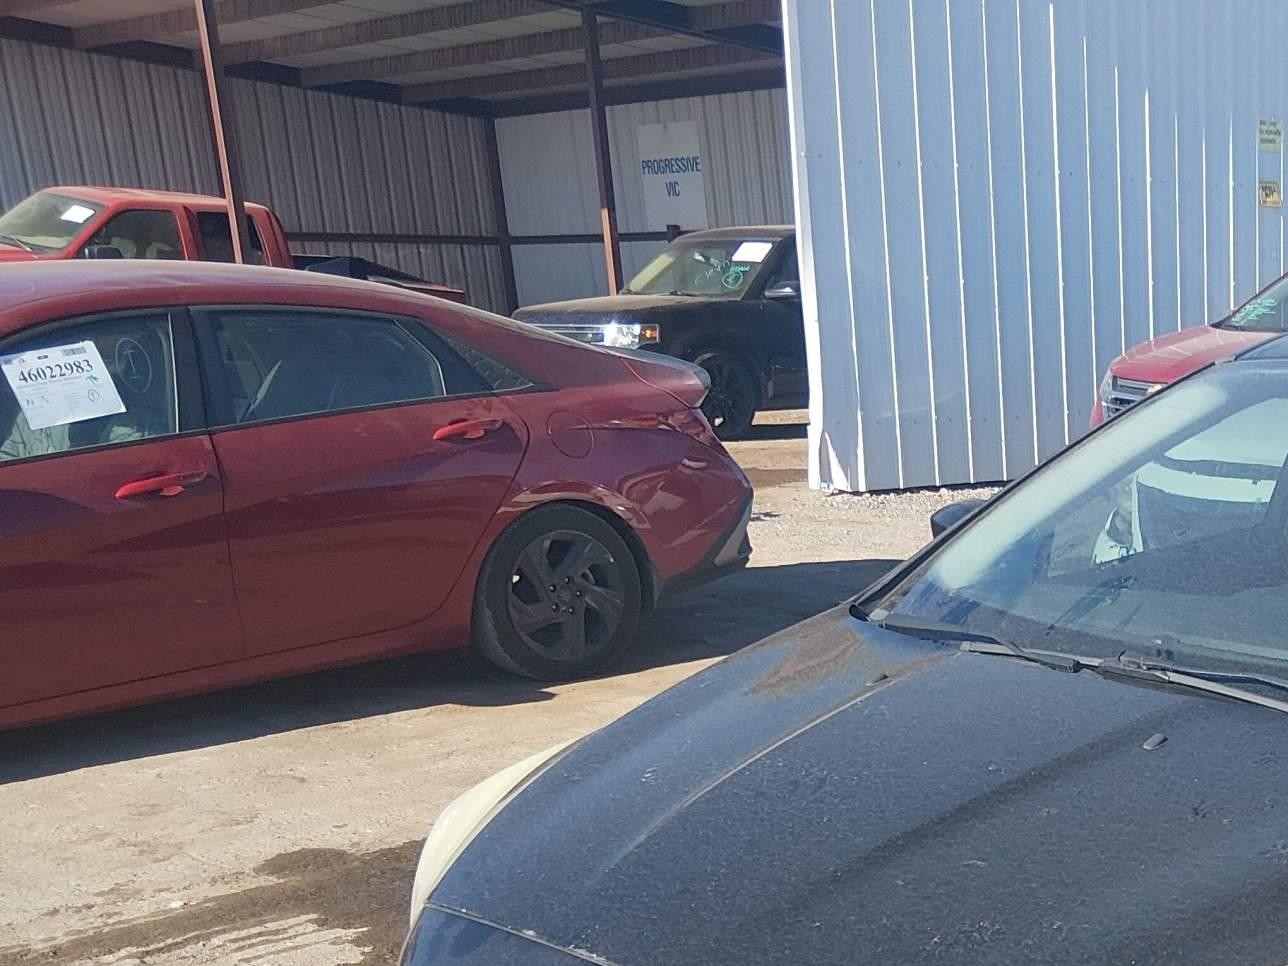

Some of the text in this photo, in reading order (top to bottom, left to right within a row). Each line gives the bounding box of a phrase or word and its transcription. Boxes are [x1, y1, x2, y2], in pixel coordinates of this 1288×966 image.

[641, 156, 701, 176] PROGRESSIVE
[665, 181, 680, 198] VIC
[18, 358, 94, 384] 46022983
